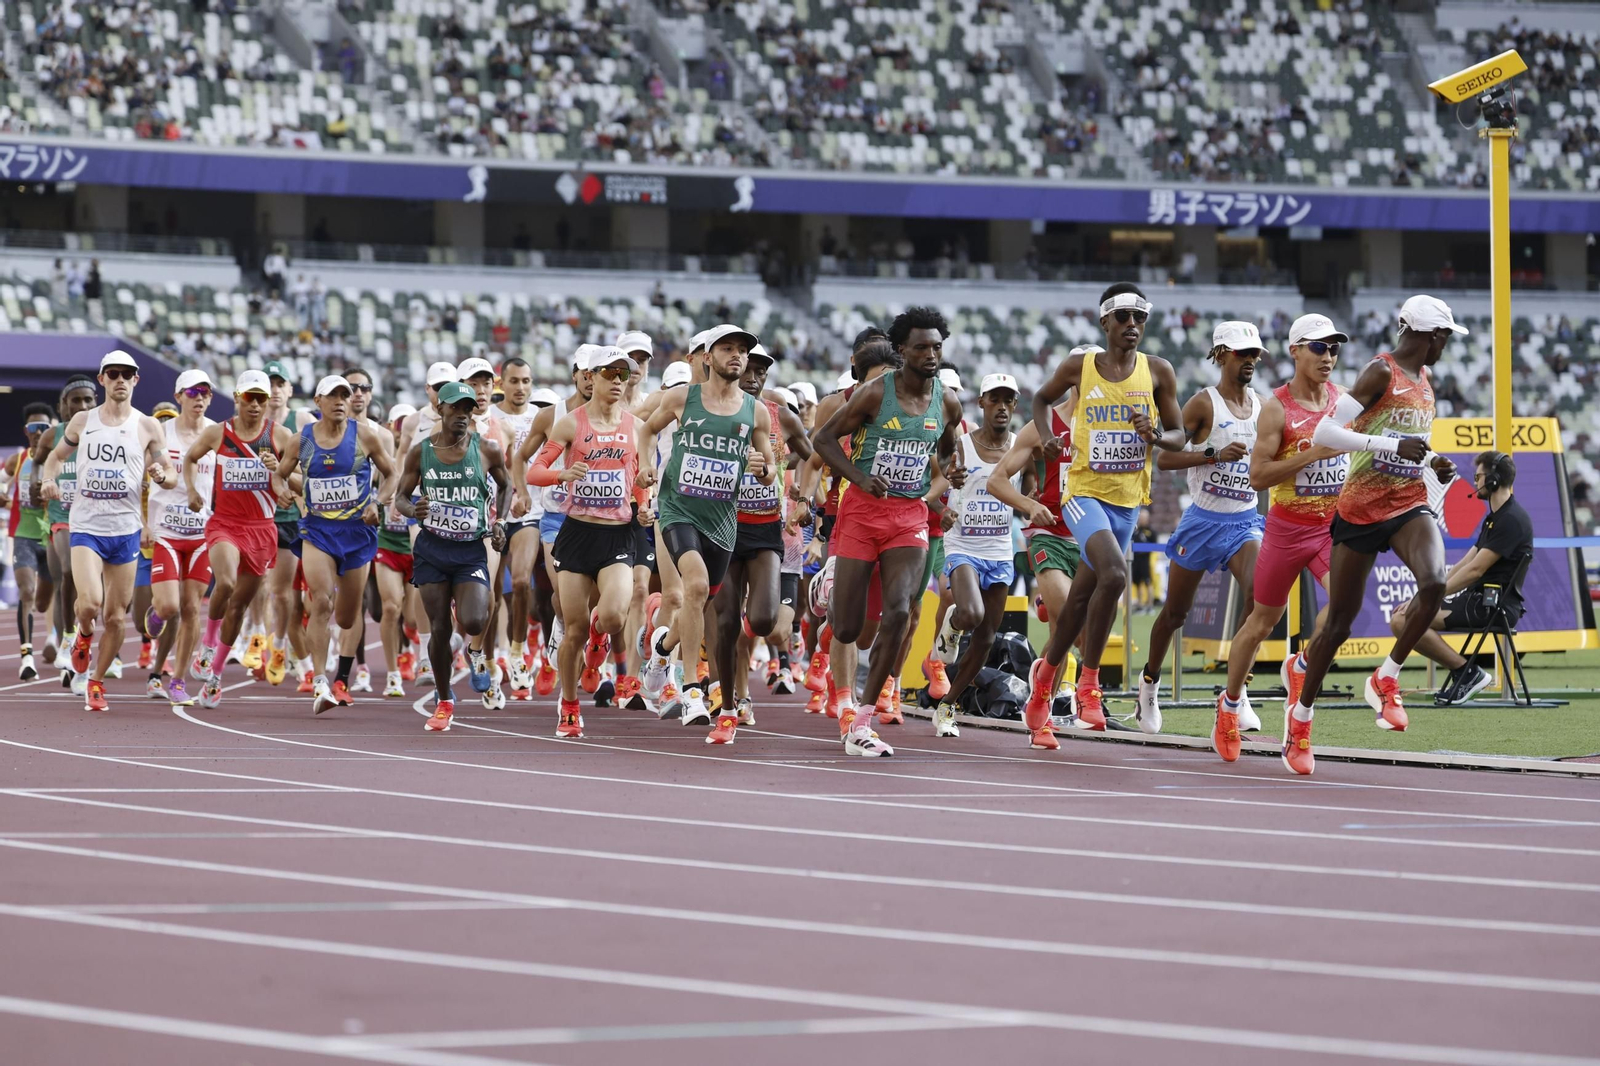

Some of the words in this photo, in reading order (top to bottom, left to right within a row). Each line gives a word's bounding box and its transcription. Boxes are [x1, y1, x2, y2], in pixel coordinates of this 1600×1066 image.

[1456, 67, 1503, 96] SEIKO
[1148, 189, 1312, 226] 男子マラソン
[458, 386, 471, 394] IRL
[1454, 424, 1547, 447] SEKO
[87, 443, 127, 465] USA
[584, 447, 625, 461] JAPAN
[1092, 447, 1102, 460] S.
[1104, 446, 1146, 460] HASSAN
[235, 459, 265, 469] TDK
[698, 458, 736, 475] TDK
[893, 454, 926, 468] TDK
[94, 469, 125, 479] TDK
[877, 463, 923, 481] TAKELE
[1229, 462, 1250, 474] TD
[225, 471, 267, 482] CHAMPI
[439, 471, 462, 479] 123.ie
[587, 471, 621, 483] TDK
[682, 470, 735, 490] CHARIK
[740, 474, 763, 486] TD
[1305, 469, 1346, 485] YANG
[86, 478, 127, 491] YOUNG
[320, 476, 352, 490] TDK
[889, 482, 921, 490] OKYO25
[318, 489, 350, 502] JAMI
[426, 486, 479, 502] IRELAND
[575, 484, 622, 497] KONDO
[691, 488, 731, 499] TOKYO25
[740, 485, 775, 500] KOECH
[1216, 488, 1254, 500] TOKYO25
[1311, 486, 1342, 494] TOKYO
[174, 504, 192, 515] TD
[441, 504, 475, 520] TDK
[977, 501, 1007, 512] TDK
[164, 514, 204, 527] GRUEN
[430, 515, 471, 531] HASO
[963, 514, 1010, 526] CHIAPPINELLI
[1339, 641, 1379, 656] EIKO
